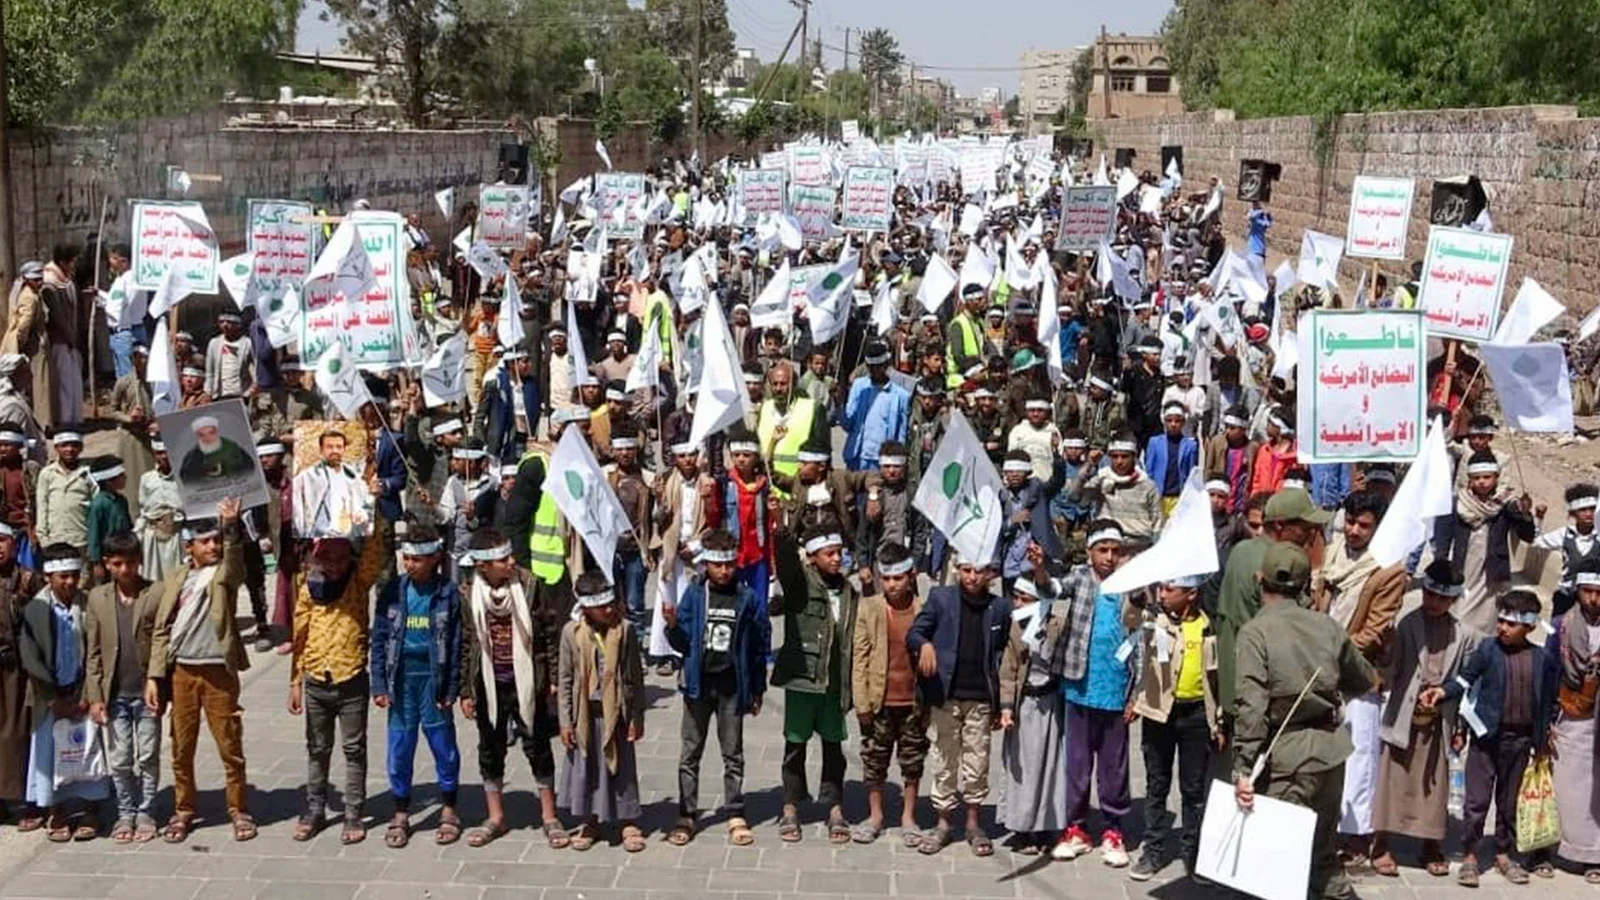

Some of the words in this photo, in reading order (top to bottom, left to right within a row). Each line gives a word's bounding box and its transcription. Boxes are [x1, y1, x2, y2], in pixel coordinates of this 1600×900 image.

[364, 233, 393, 253] الله
[1435, 237, 1502, 263] قاطعوا
[1464, 272, 1498, 288] البضائع
[343, 311, 362, 331] على
[365, 310, 395, 326] اللعنة
[359, 331, 399, 358] النصر
[1319, 322, 1417, 357] قاطعوا
[1318, 361, 1370, 390] الأمريكية
[1370, 362, 1417, 389] البضائع
[1361, 393, 1371, 414] و
[1319, 420, 1416, 447] الإسرائيلية
